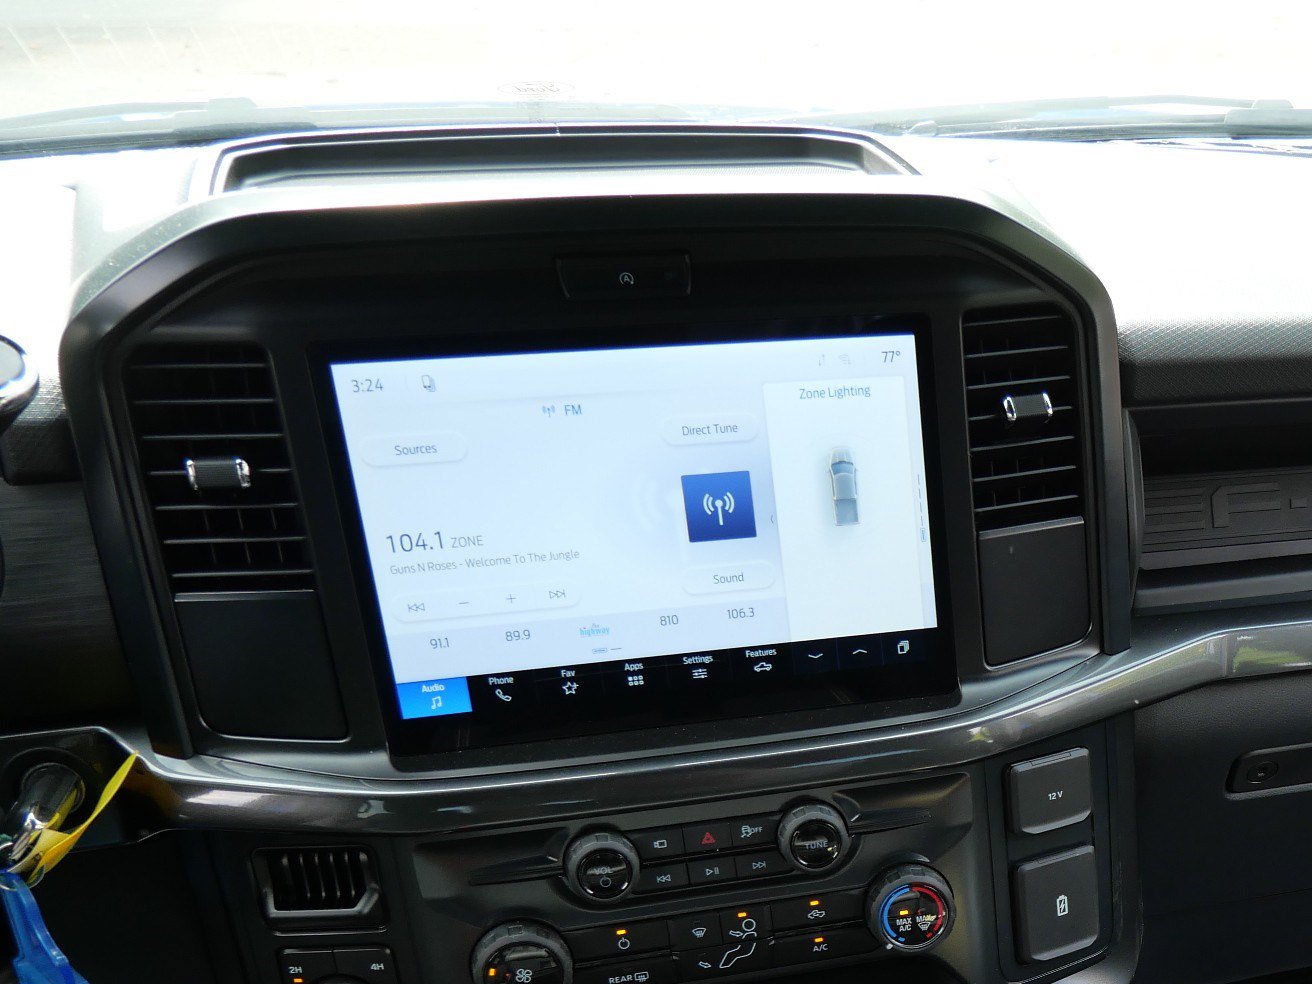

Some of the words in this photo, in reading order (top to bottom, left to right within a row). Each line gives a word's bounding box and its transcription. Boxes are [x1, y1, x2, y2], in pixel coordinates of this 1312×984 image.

[352, 378, 384, 393] 3:24
[799, 387, 826, 399] Zone
[828, 384, 871, 399] Lighting
[564, 404, 582, 416] FM
[681, 424, 711, 437] Direct
[714, 422, 738, 435] Tune
[394, 442, 438, 457] Sources
[386, 531, 445, 554] 104.1
[451, 535, 484, 549] ZONE
[390, 564, 416, 576] Guns
[418, 563, 426, 572] N
[427, 560, 457, 572] Roses
[465, 556, 512, 569] Welcome
[513, 554, 526, 565] To
[528, 552, 547, 563] The
[549, 549, 580, 563] Jungle
[713, 572, 745, 584] Sound
[727, 607, 756, 620] 106.3
[660, 615, 679, 626] 810
[580, 626, 610, 637] highway
[430, 637, 450, 649] 91.1
[505, 629, 531, 642] 89.9
[745, 647, 777, 658] Features
[682, 654, 714, 665] Settings
[561, 668, 576, 678] Fav
[624, 662, 644, 673] Apps
[488, 676, 514, 686] Phone
[421, 683, 445, 693] Audio
[1048, 792, 1057, 801] 12
[805, 840, 828, 849] TUNE
[594, 866, 613, 875] VOL
[896, 917, 912, 926] MAX
[900, 924, 912, 932] A/C
[812, 943, 828, 952] A/C
[289, 966, 302, 974] 2H
[370, 963, 384, 971] 4H
[608, 974, 633, 984] REAR
